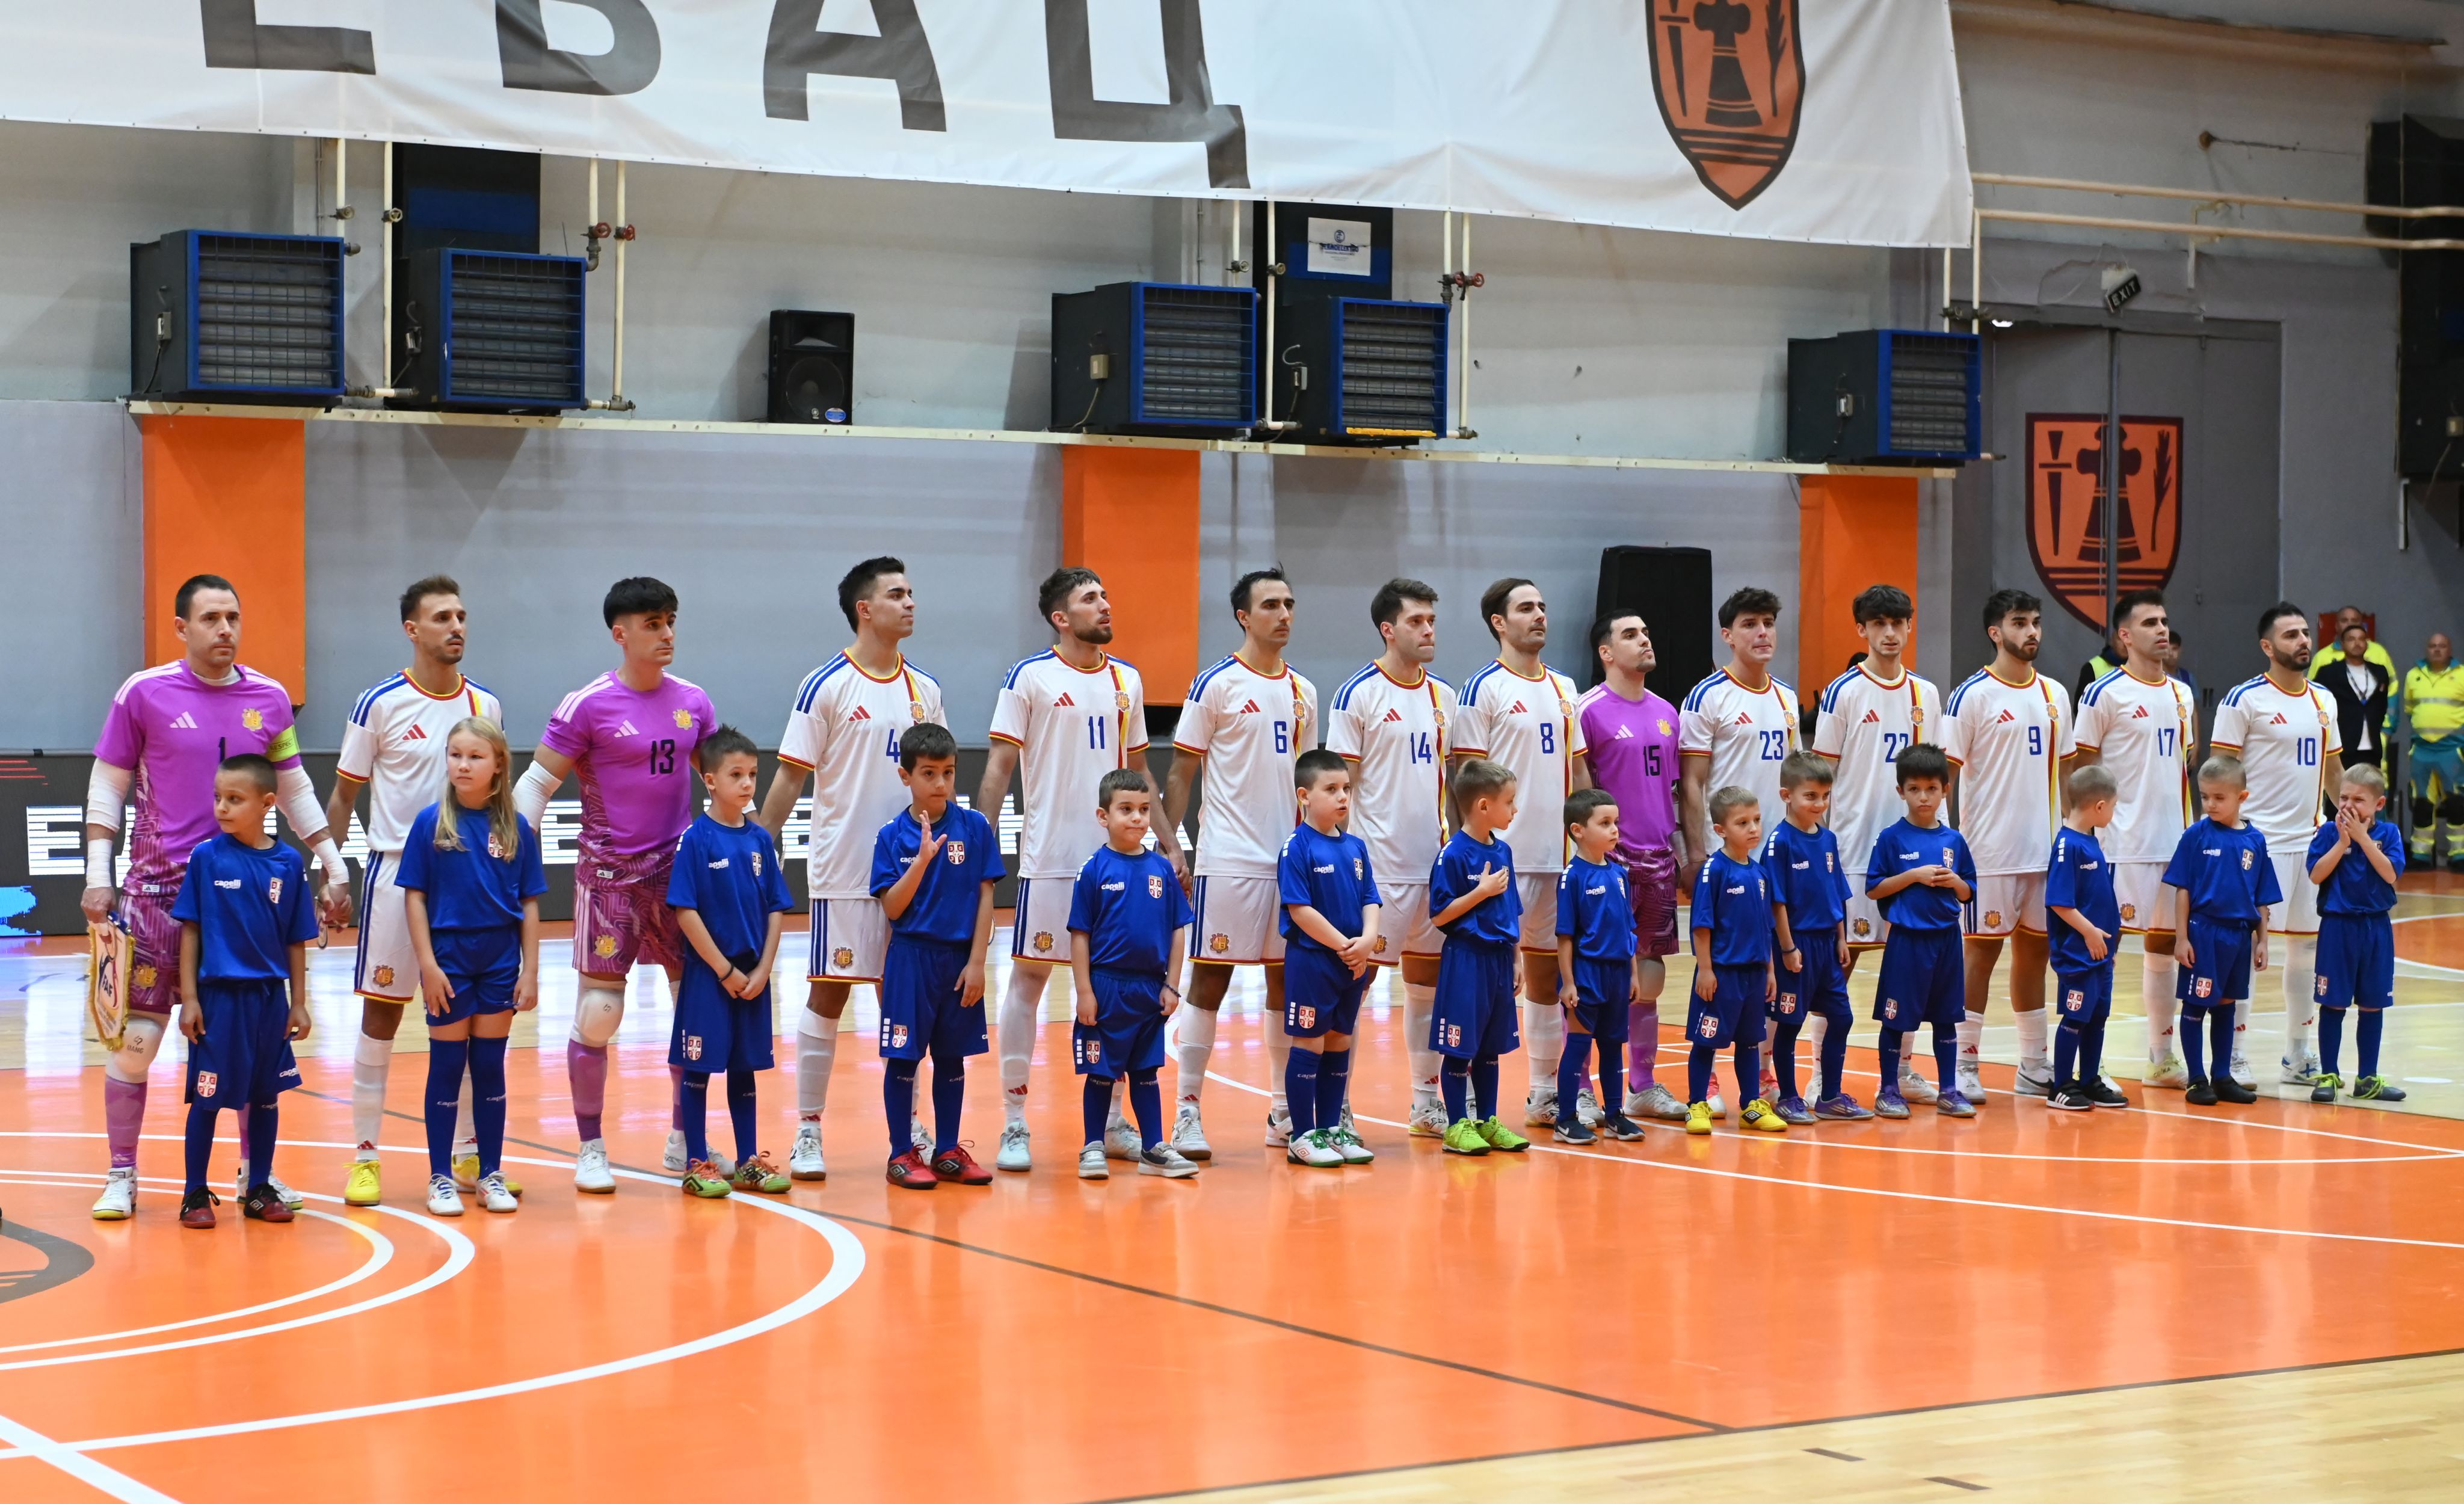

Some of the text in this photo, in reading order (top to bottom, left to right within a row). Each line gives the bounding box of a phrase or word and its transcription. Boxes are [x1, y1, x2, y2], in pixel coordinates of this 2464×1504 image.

[2111, 280, 2136, 306] EXIT
[886, 729, 901, 763] 4
[1088, 715, 1104, 750] 11
[1274, 721, 1287, 754] 6
[1540, 723, 1554, 754] 8
[1759, 730, 1784, 760] 23
[2028, 726, 2042, 755] 9
[2157, 728, 2175, 757] 17
[650, 739, 675, 774] 13
[1409, 732, 1432, 764] 14
[1642, 745, 1660, 776] 15
[2296, 737, 2316, 766] 10
[709, 857, 729, 868] apelli
[1314, 863, 1334, 873] capelli
[214, 879, 241, 888] capelli
[1101, 881, 1124, 890] capelli
[102, 974, 113, 997] FAF
